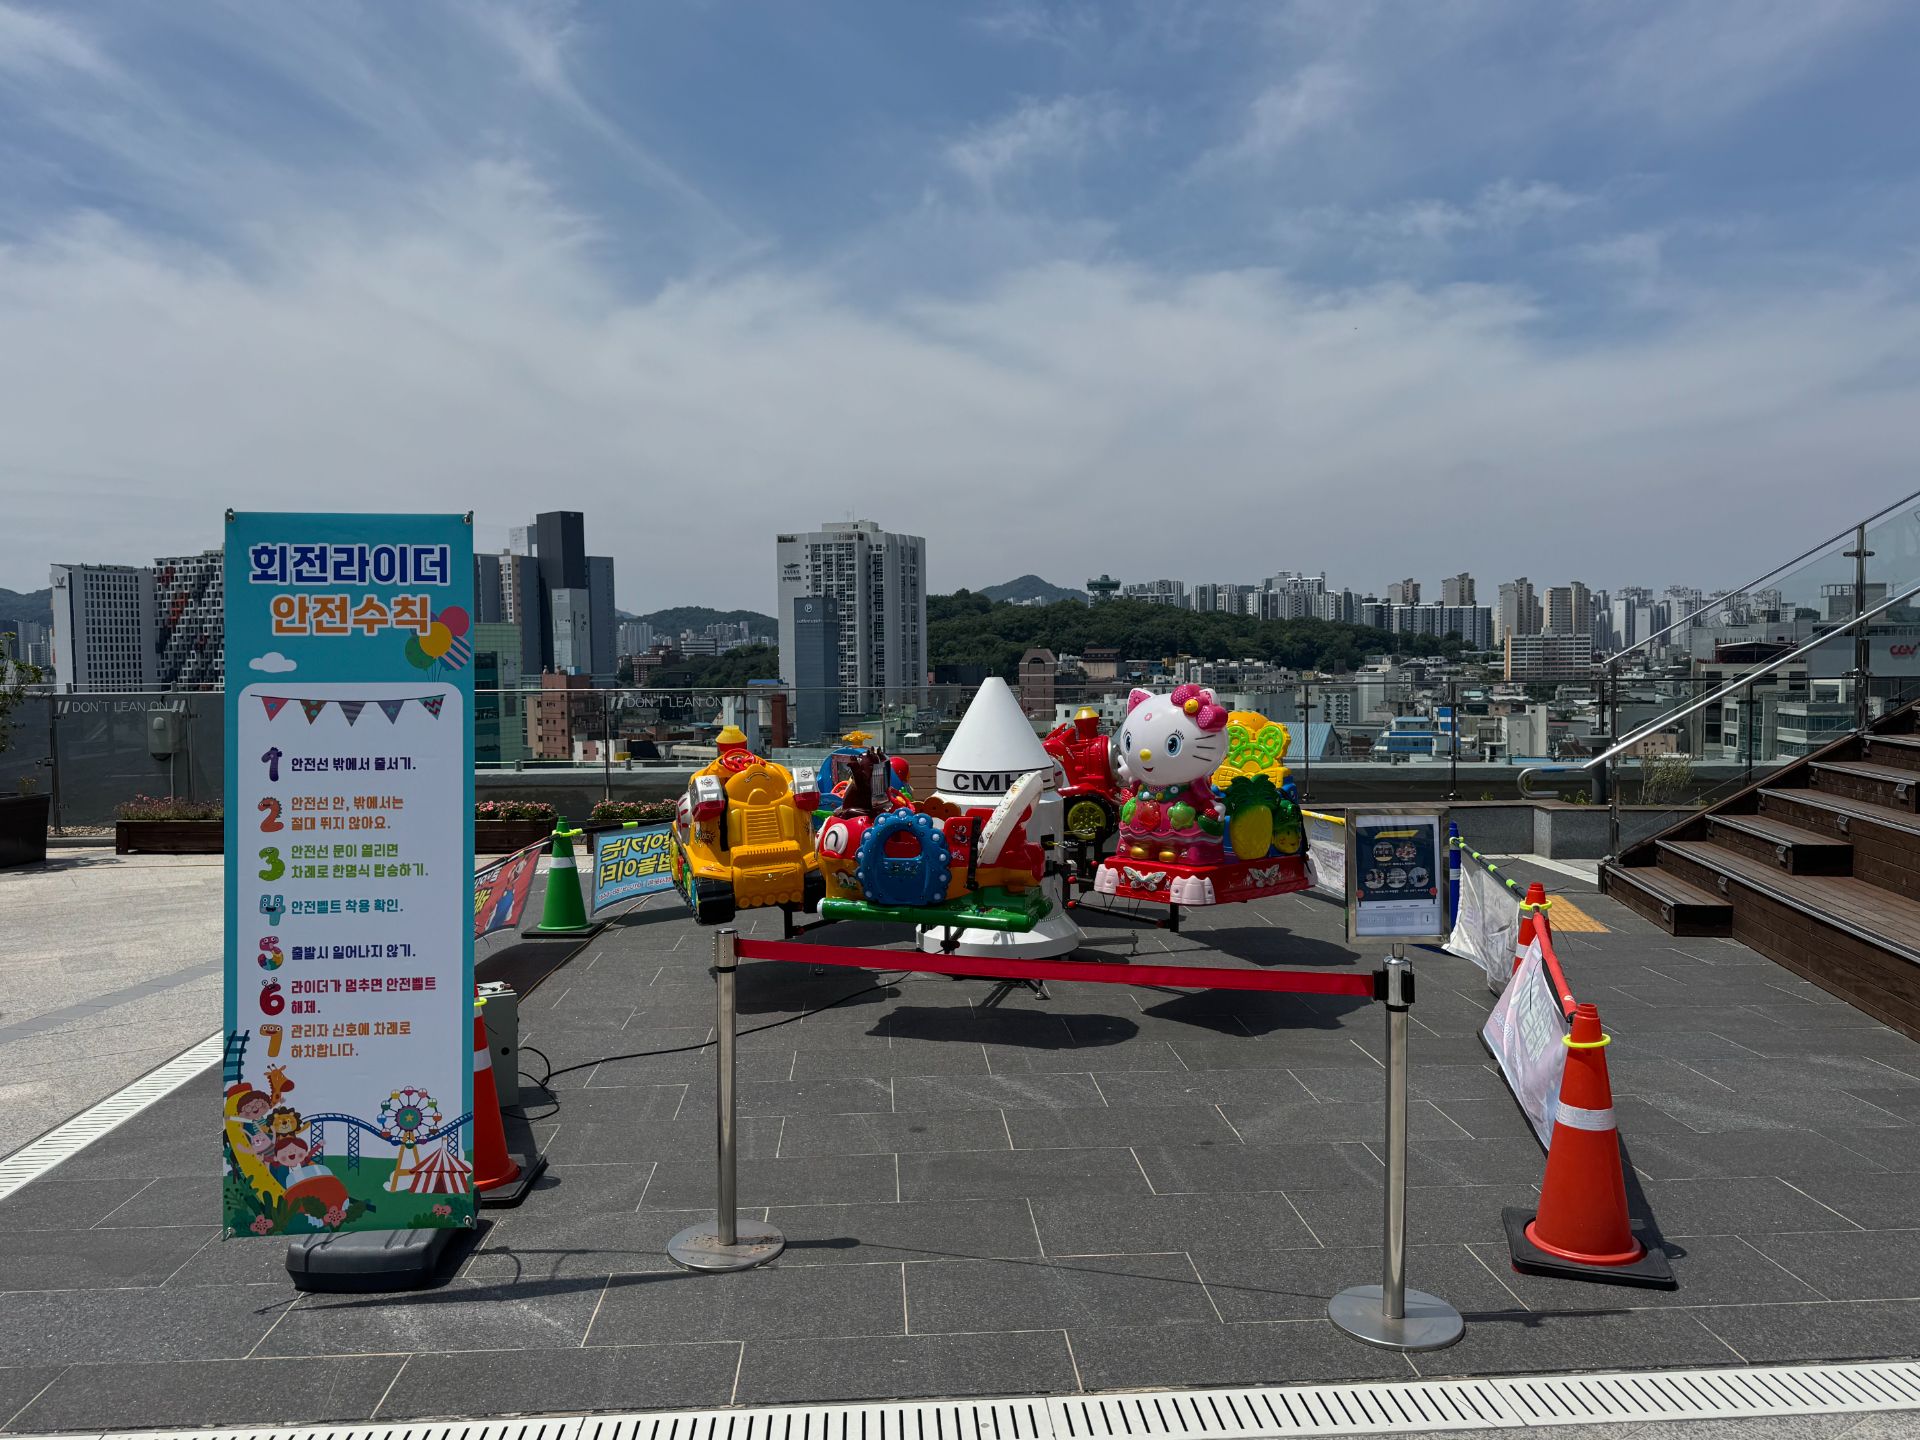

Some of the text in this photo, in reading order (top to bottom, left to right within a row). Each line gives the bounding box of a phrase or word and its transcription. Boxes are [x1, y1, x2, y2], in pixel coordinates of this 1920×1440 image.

[249, 544, 451, 585] 회전라이더
[270, 594, 431, 636] 안전수칙
[1890, 644, 1917, 657] CGV
[72, 700, 110, 713] DON'T
[114, 701, 146, 713] LEAN
[669, 696, 701, 708] LEAN
[292, 758, 328, 771] 안전선
[333, 757, 369, 771] 밖에서
[374, 757, 416, 771] 줄서기.
[292, 797, 329, 811] 안전선
[333, 796, 349, 812] 안,
[354, 796, 404, 810] 밖에서는
[291, 816, 390, 831] 절대 뛰지 않아요.
[291, 845, 328, 860] 안전선
[333, 844, 357, 859] 문이
[361, 843, 398, 858] 열리면
[291, 863, 428, 878] 차례로 한명식 탑승하기.
[292, 900, 341, 914] 안전벨트
[346, 899, 370, 913] 착용
[374, 899, 403, 912] 확인.
[292, 946, 328, 960] 출발시
[333, 945, 382, 959] 일어나지
[387, 944, 416, 958] 않기.
[291, 979, 342, 994] 라이더가
[346, 977, 383, 992] 멈추면
[387, 976, 436, 992] 안전벨트
[291, 1000, 320, 1014] 해제.
[291, 1024, 329, 1038] 관리자
[333, 1022, 370, 1037] 신호에
[374, 1021, 411, 1037] 차례로
[291, 1043, 358, 1058] 하차합니다.
